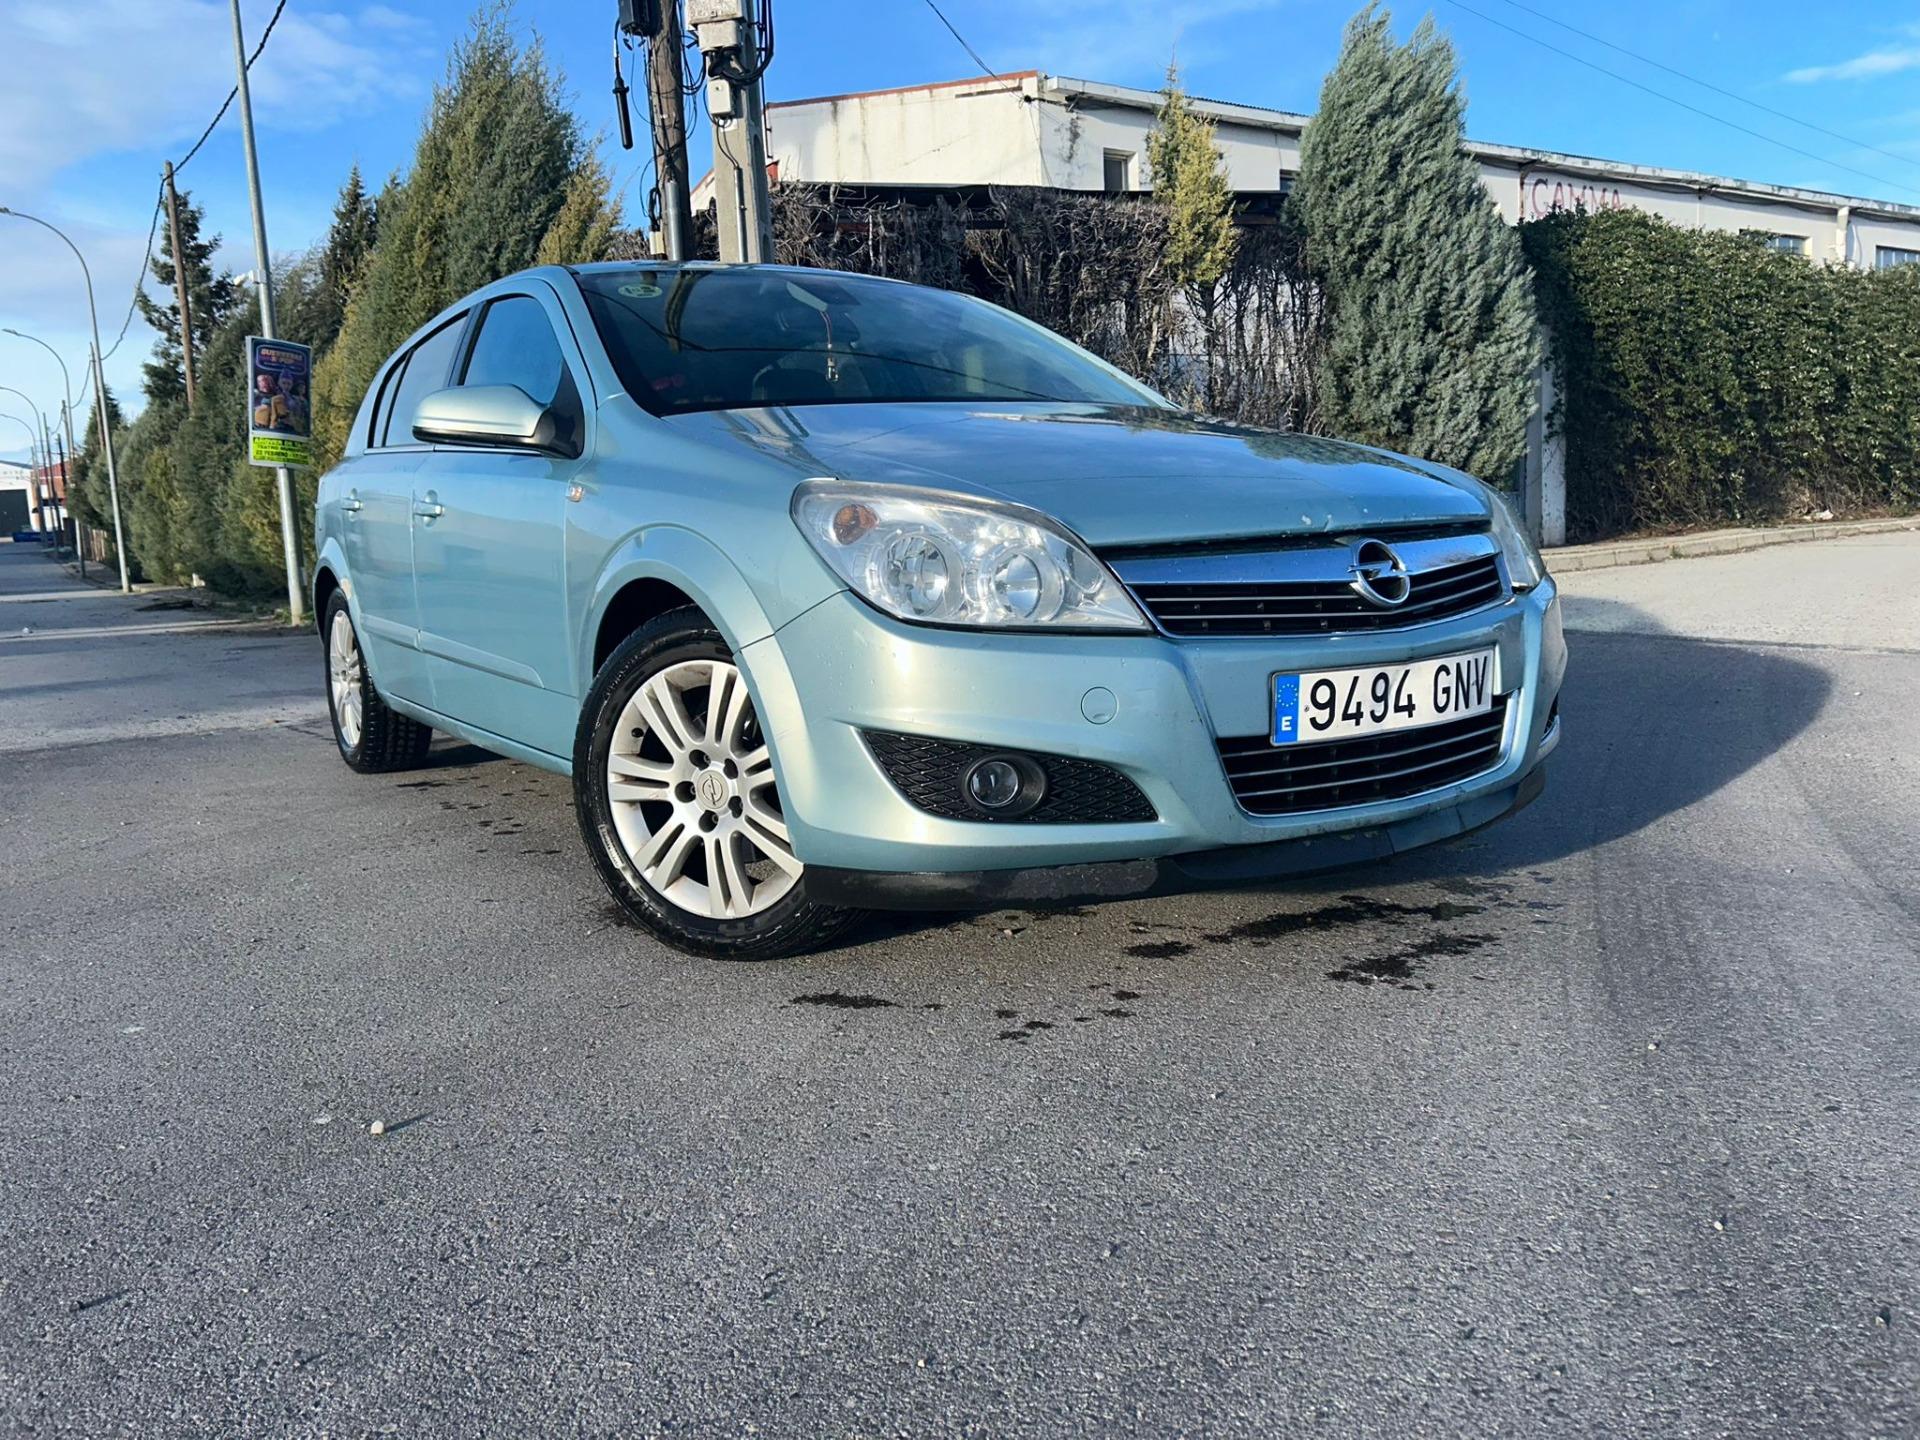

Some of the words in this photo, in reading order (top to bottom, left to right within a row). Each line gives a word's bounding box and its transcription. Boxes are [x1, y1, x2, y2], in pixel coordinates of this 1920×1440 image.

[1309, 669, 1416, 731] 9494
[1433, 656, 1488, 714] GNV
[1281, 716, 1293, 731] E
